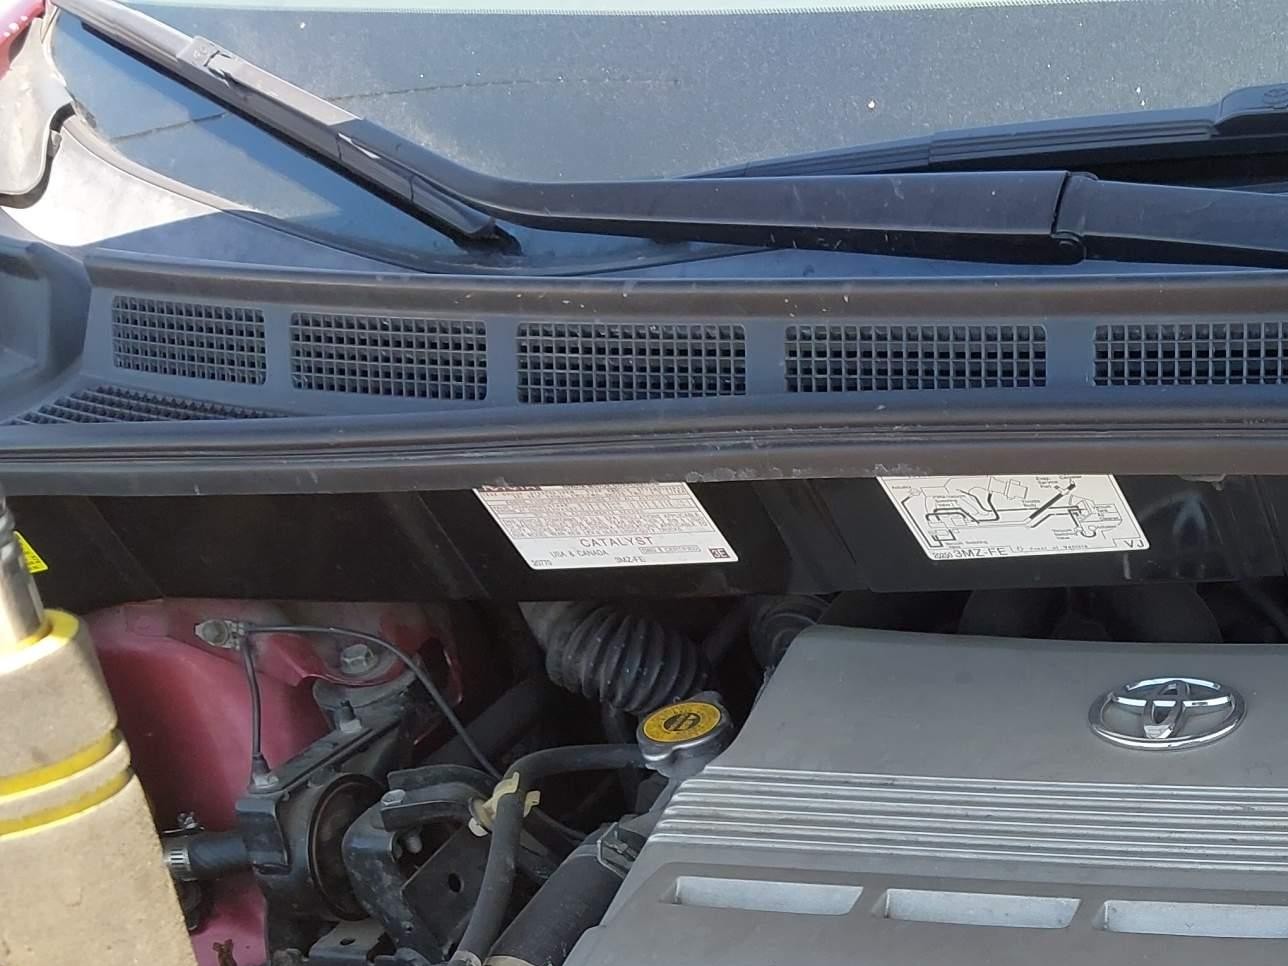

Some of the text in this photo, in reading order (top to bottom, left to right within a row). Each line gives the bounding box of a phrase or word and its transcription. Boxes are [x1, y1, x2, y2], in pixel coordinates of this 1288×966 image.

[580, 536, 653, 548] CATALYST
[1124, 539, 1144, 549] VJ
[577, 549, 608, 557] CANADA
[953, 547, 1008, 557] 3MZ-FE
